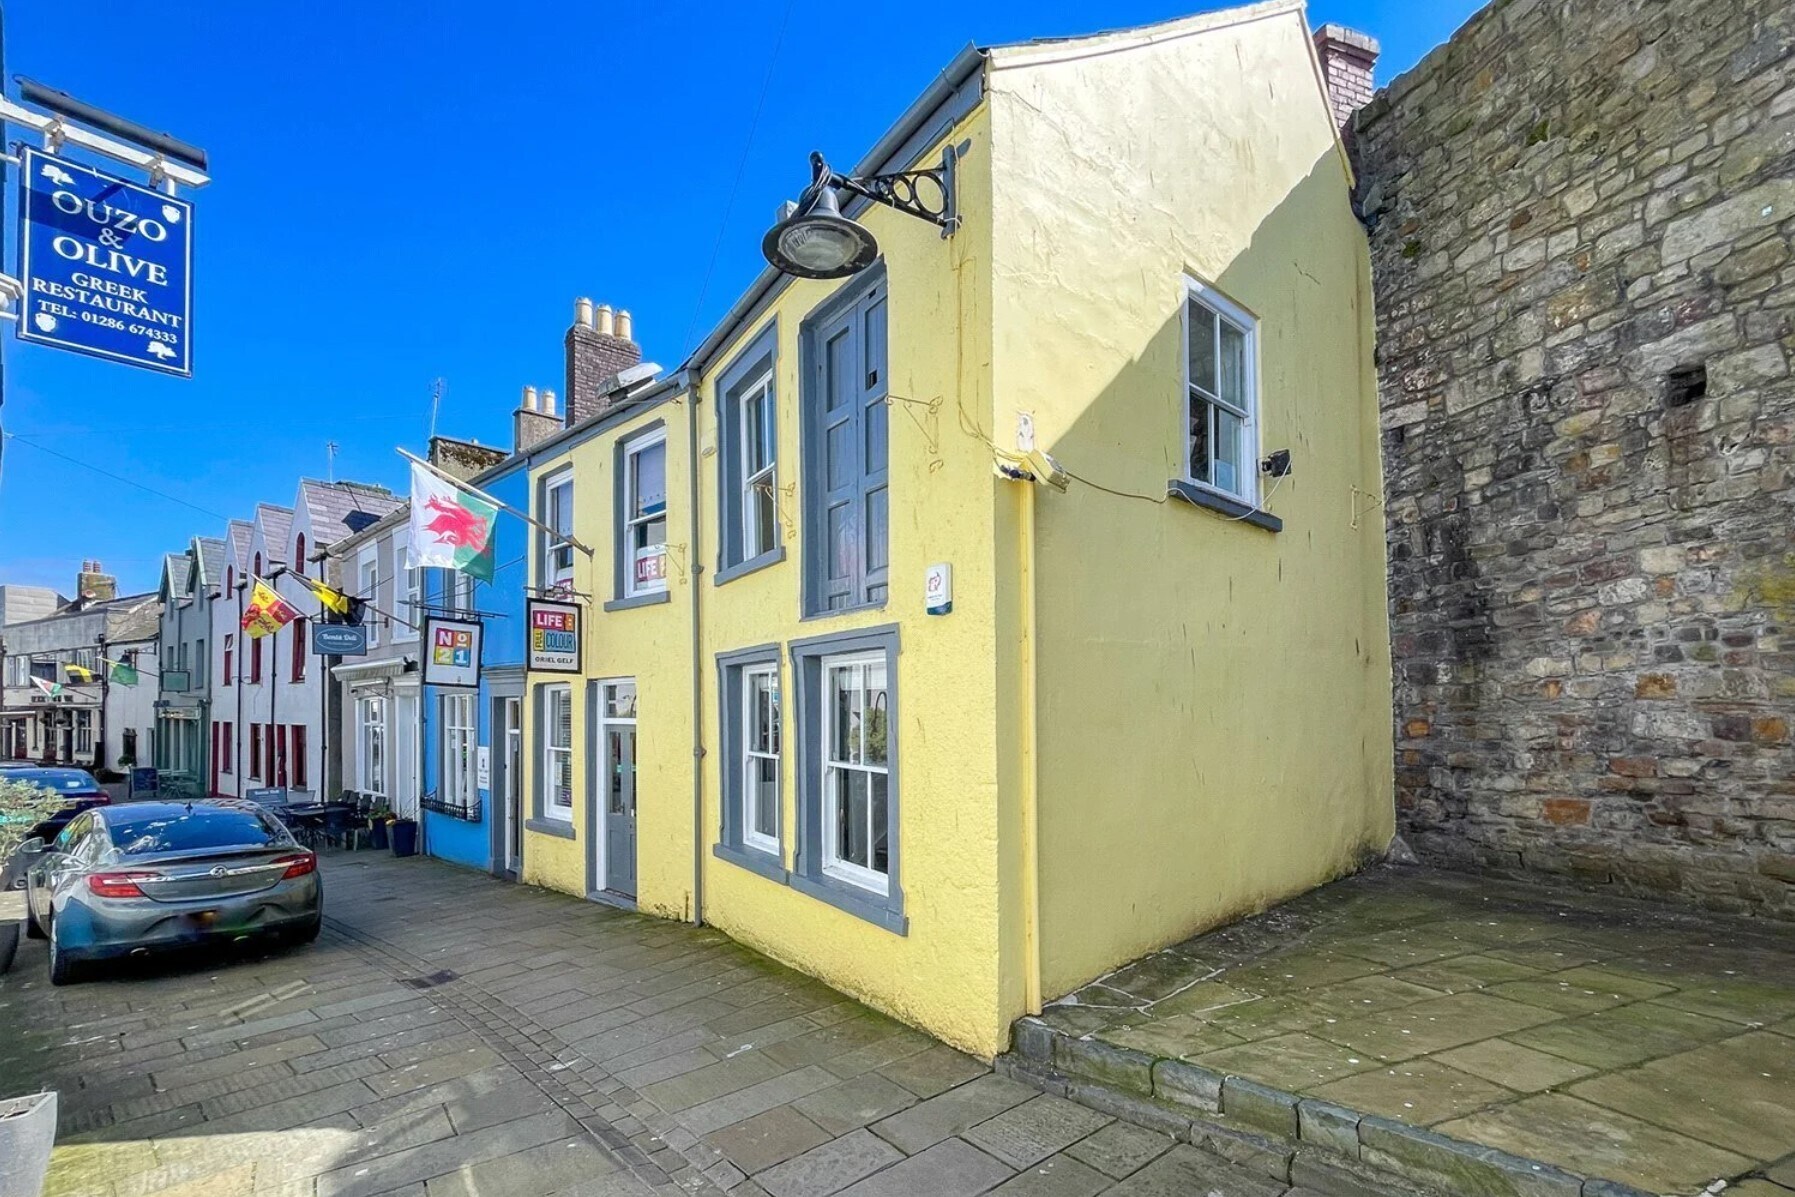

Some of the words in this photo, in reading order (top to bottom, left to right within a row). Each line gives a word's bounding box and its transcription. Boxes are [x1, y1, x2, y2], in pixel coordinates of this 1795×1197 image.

[52, 190, 167, 242] OUZO
[98, 228, 124, 250] &
[53, 236, 168, 286] OLIVE
[32, 277, 183, 328] RESTAURANT
[71, 272, 148, 304] GREEK
[37, 299, 77, 319] TEL:
[81, 311, 125, 330] 01286
[129, 323, 177, 344] 674333
[537, 613, 563, 627] LIFE
[438, 649, 467, 664] 21
[545, 632, 573, 649] COLOUR
